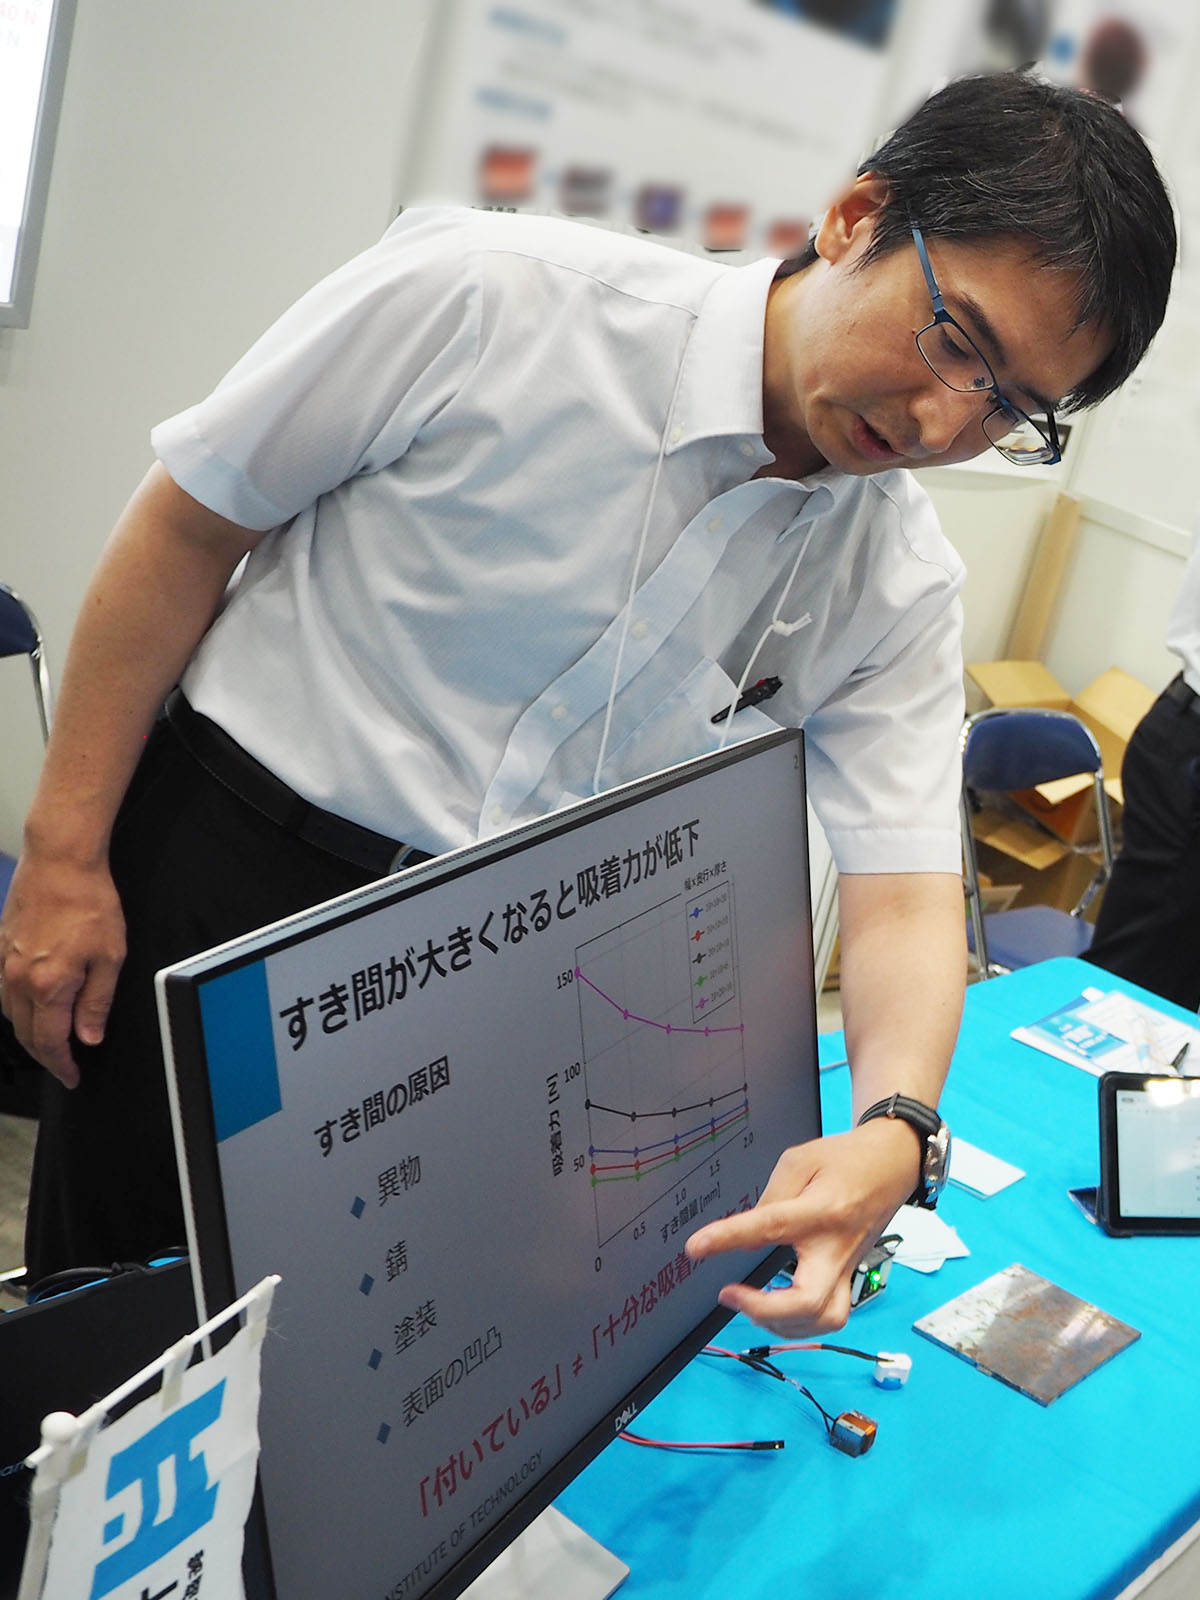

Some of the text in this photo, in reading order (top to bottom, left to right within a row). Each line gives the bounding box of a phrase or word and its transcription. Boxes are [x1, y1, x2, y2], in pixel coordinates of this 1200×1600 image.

[279, 819, 700, 1051] すき間が大きくなると吸着力が低下
[557, 969, 573, 990] 150
[564, 1062, 581, 1083] 100
[314, 1055, 450, 1158] すき間の原因
[548, 1110, 564, 1176] 吸着力
[743, 1132, 754, 1149] 2.0
[378, 1155, 421, 1207] 異物
[573, 1154, 585, 1172] 50
[709, 1160, 720, 1177] 1.5
[675, 1188, 687, 1206] 1.0
[633, 1221, 646, 1241] 0.5
[386, 1240, 408, 1283] 錆
[594, 1256, 602, 1272] 0
[394, 1299, 438, 1355] 塗装
[402, 1326, 502, 1427] 表面の凹凸
[615, 1402, 638, 1431] DELL
[419, 1363, 562, 1517] 「付いている」
[450, 1525, 467, 1548] OF
[469, 1448, 544, 1529] TECHNOLOGY
